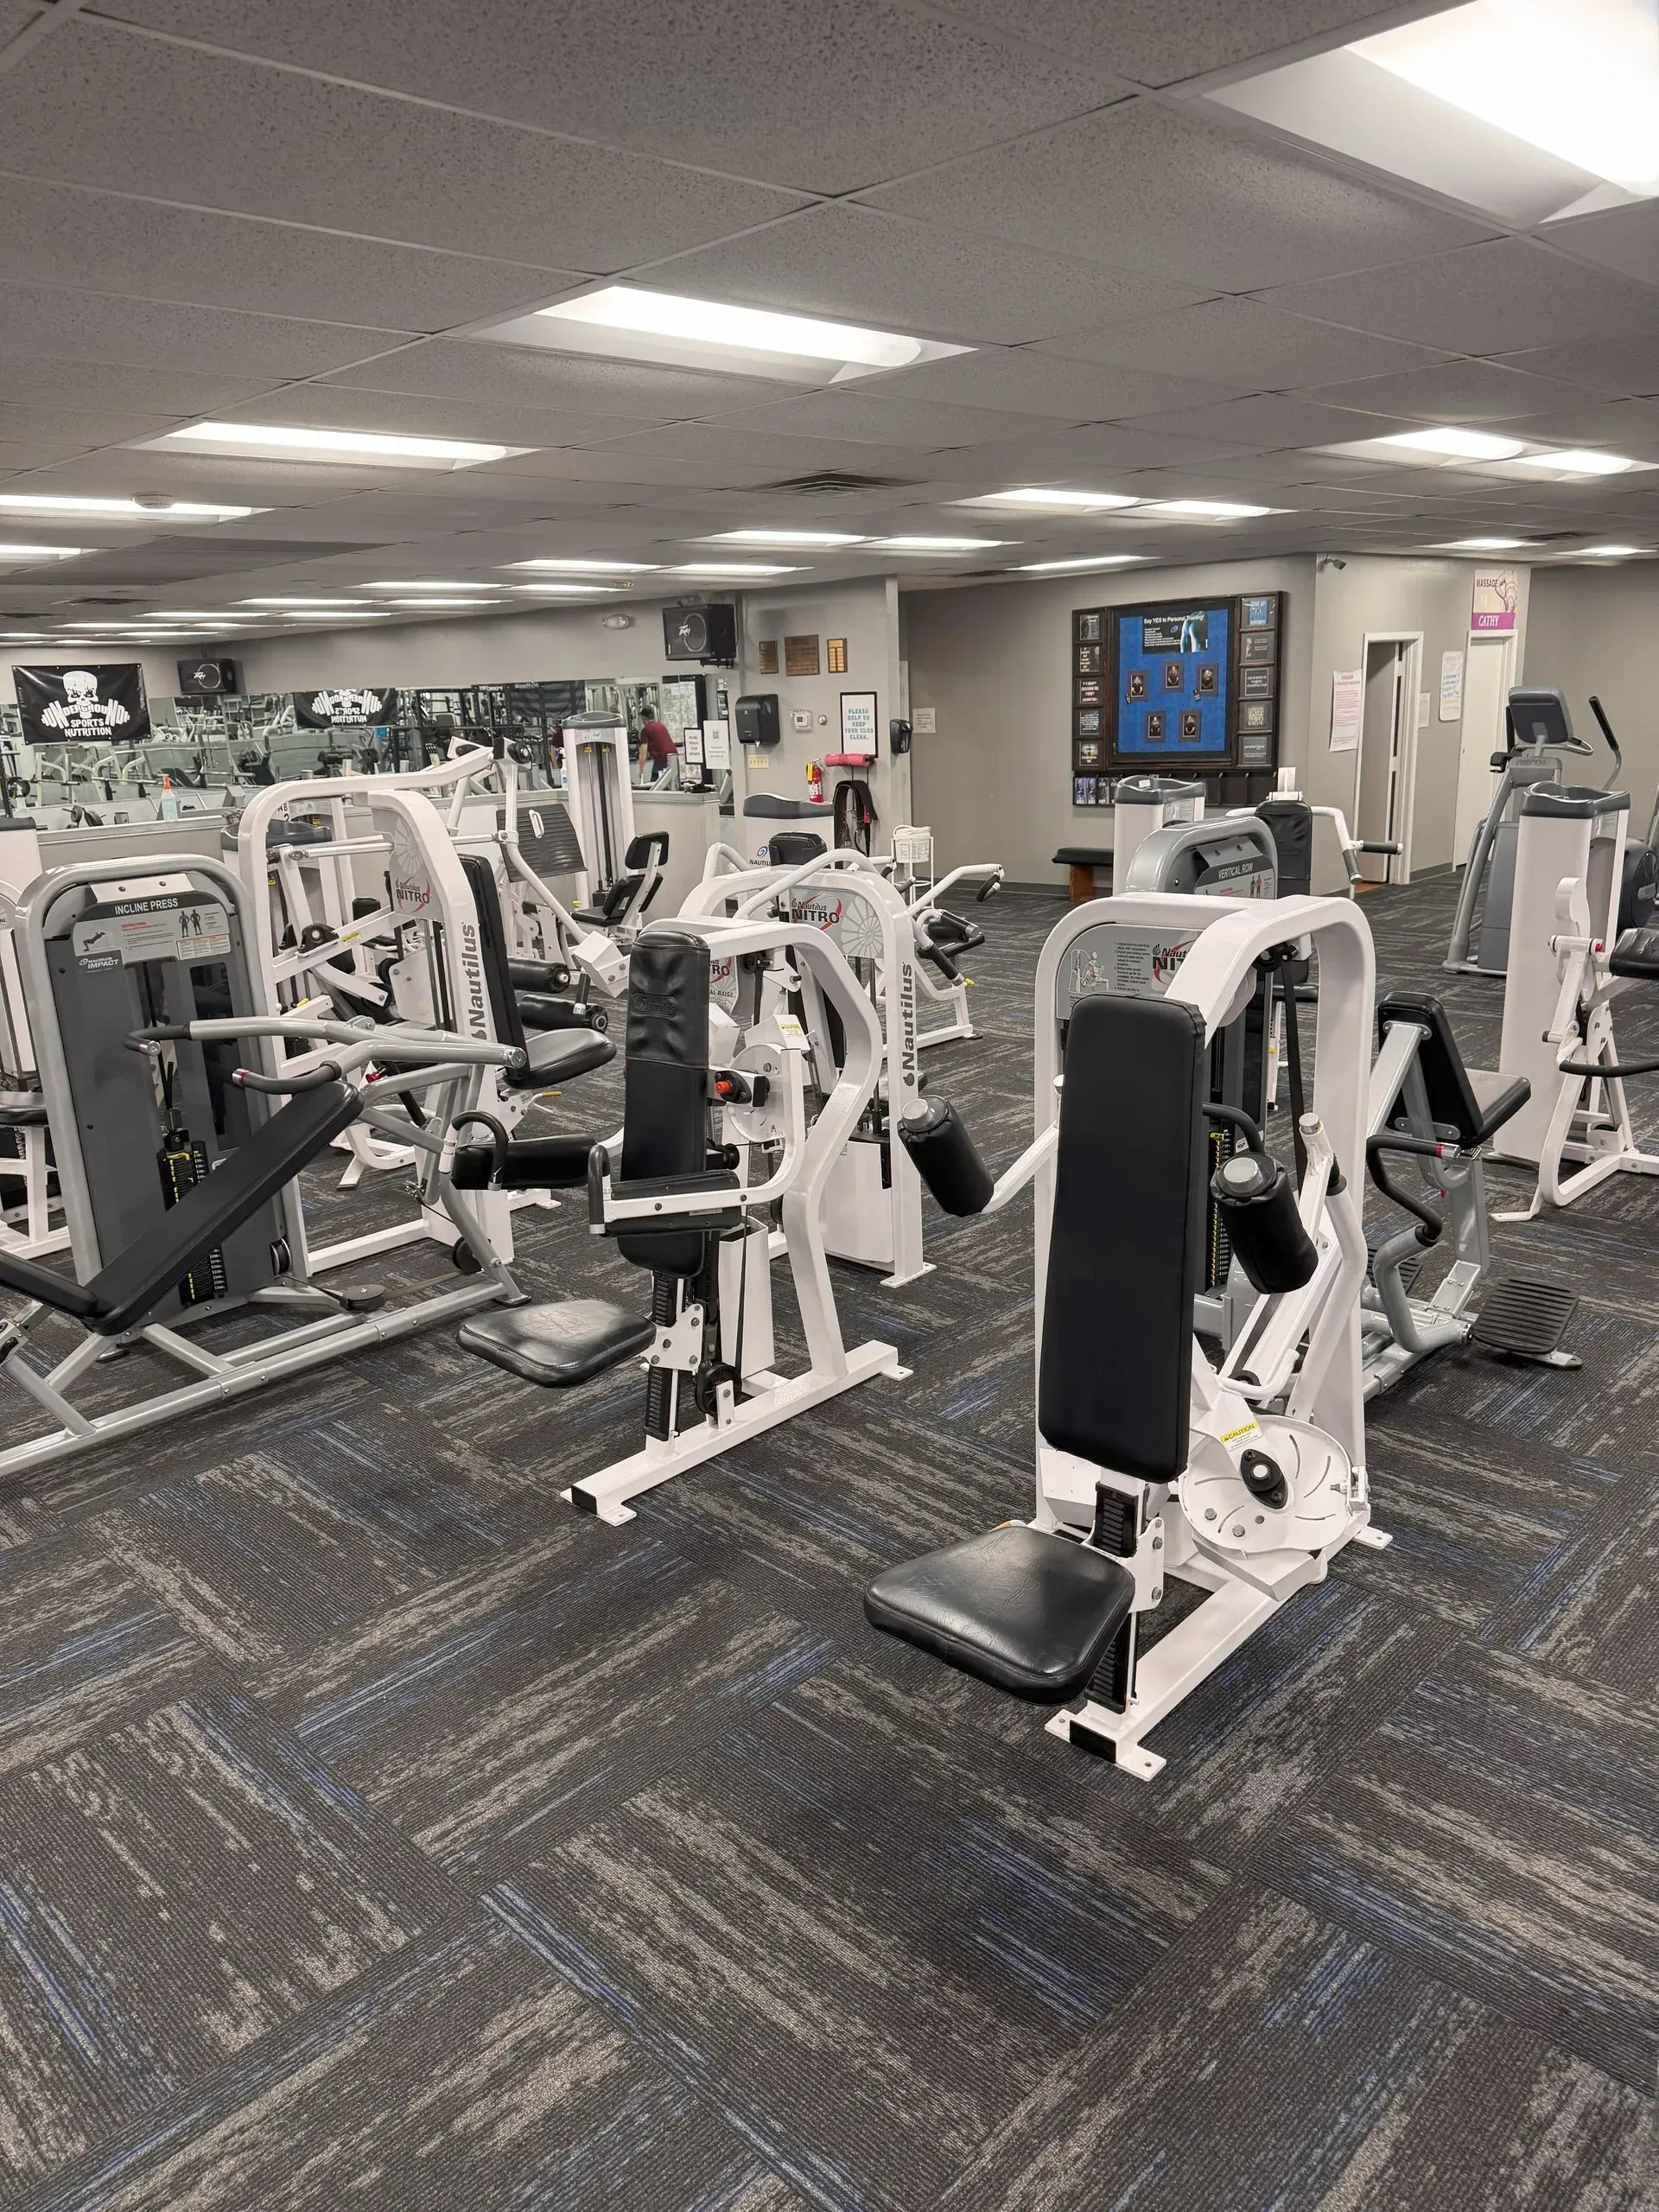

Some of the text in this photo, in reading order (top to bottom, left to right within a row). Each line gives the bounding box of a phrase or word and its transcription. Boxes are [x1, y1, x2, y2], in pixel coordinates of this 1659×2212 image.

[1477, 578, 1498, 588] MASSAGE
[1478, 614, 1500, 627] CATHY
[70, 718, 105, 728] SPORTS
[64, 727, 112, 738] NUTRITION
[1217, 862, 1254, 880] VERTICAL ROW
[396, 888, 429, 904] NITRO
[114, 898, 179, 916] INCLINE PRESS
[798, 900, 827, 912] Nautilus
[791, 908, 840, 924] NITRO
[87, 958, 119, 969] IMPACT
[461, 922, 486, 1028] Nautilus
[900, 963, 915, 1071] Nautilus
[1228, 1424, 1255, 1440] CAUTION
